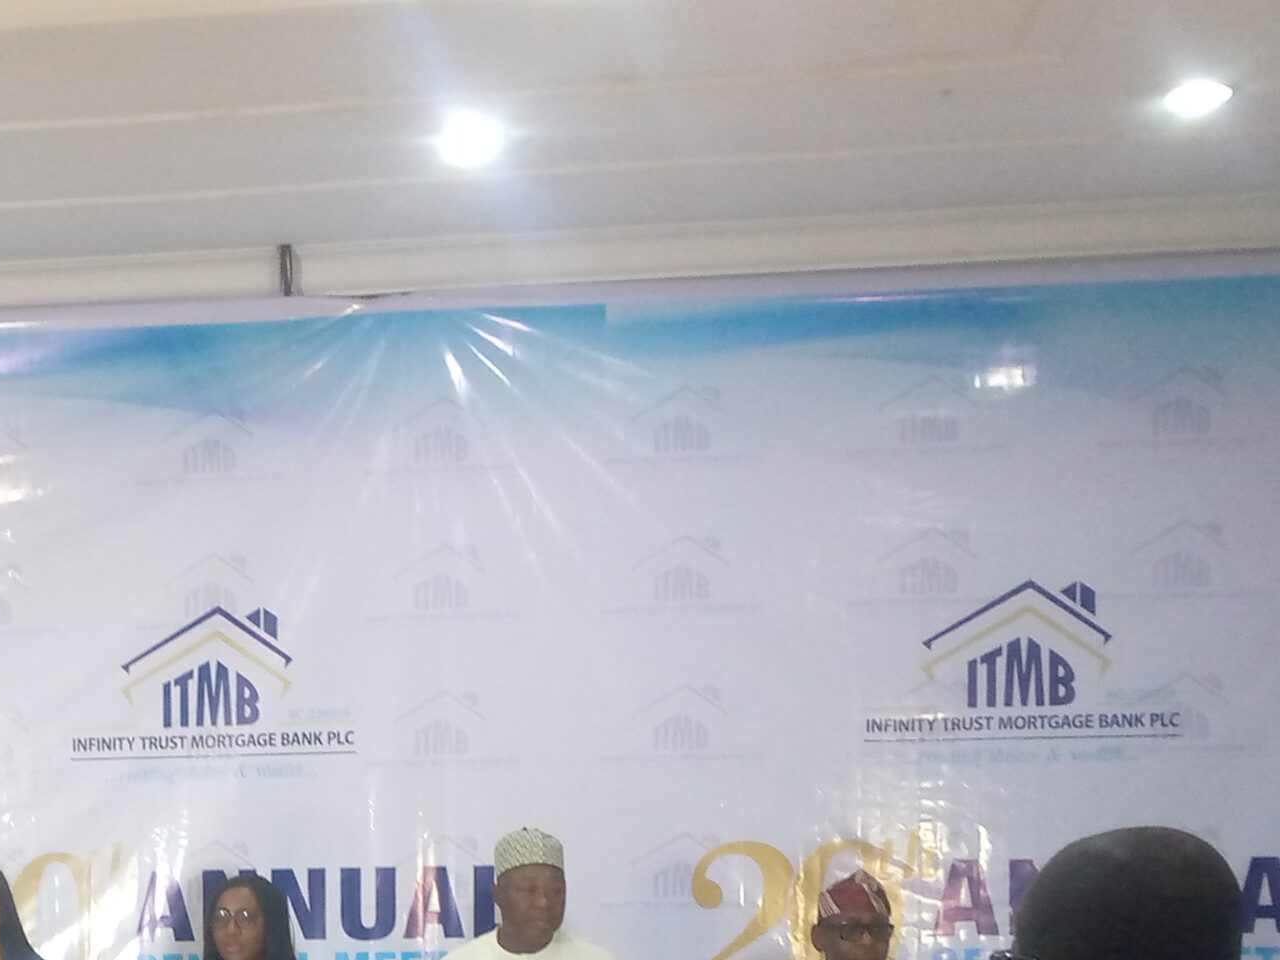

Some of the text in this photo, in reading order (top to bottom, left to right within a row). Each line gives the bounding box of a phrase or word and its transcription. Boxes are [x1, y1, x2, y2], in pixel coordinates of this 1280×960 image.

[163, 660, 260, 728] ITMB
[967, 637, 1076, 708] ITMB
[72, 730, 355, 752] INFINITY TRUST MORTGAGE BANK PLC
[866, 711, 1182, 733] INFINITY TRUST MORTGAGE BANK PLC
